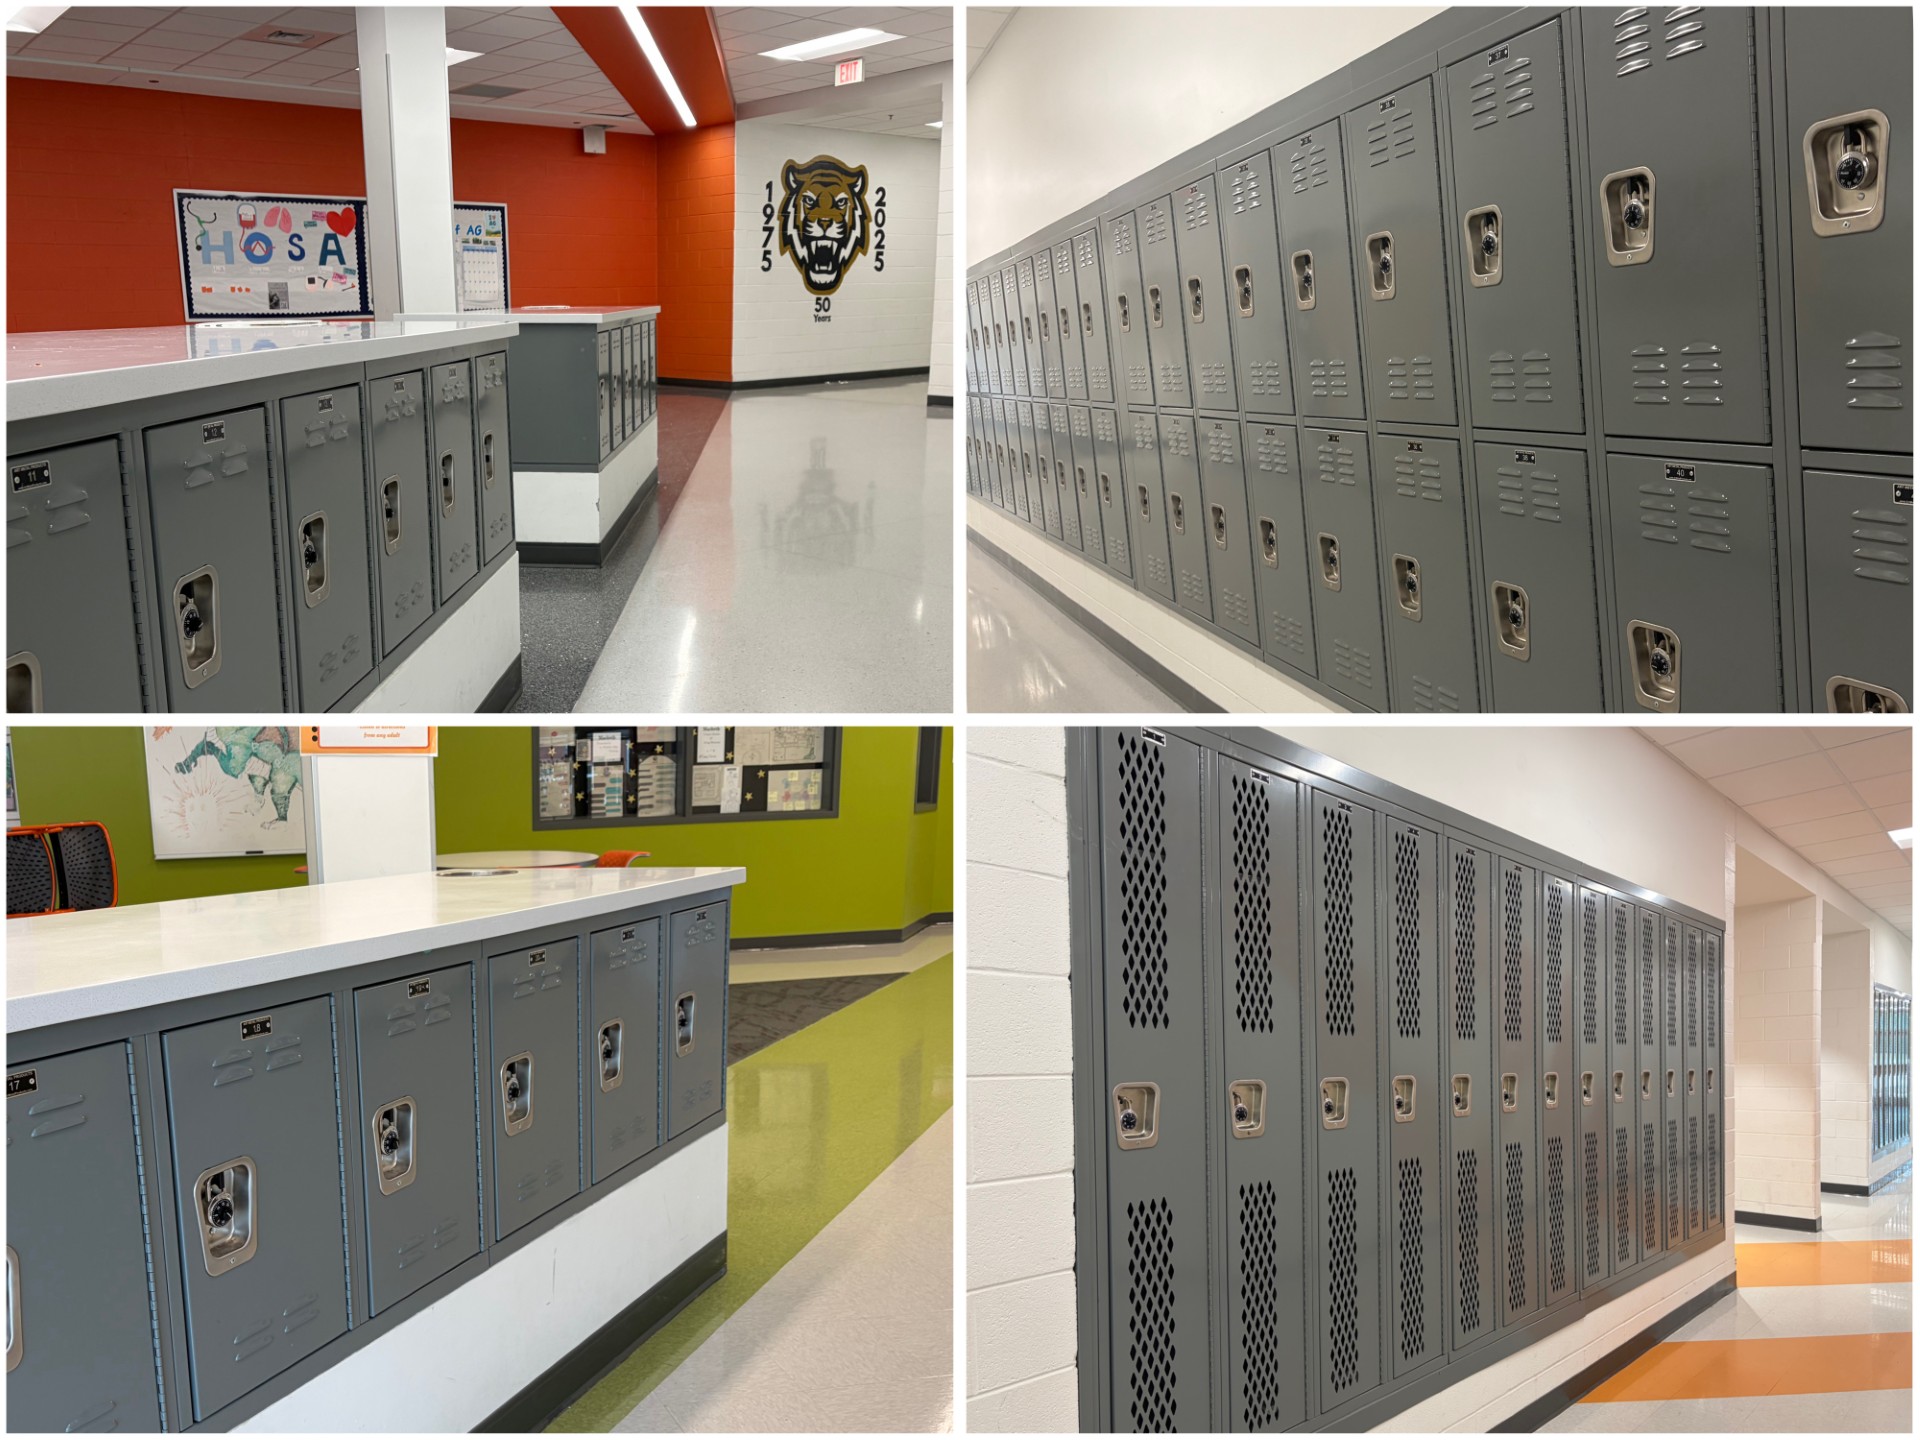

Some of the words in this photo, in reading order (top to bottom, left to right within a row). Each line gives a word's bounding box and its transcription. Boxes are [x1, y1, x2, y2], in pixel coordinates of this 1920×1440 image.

[840, 61, 858, 83] EXIT
[466, 225, 482, 236] AG
[761, 181, 775, 272] 1975
[874, 187, 886, 272] 2025
[201, 230, 346, 266] HOSA
[814, 297, 831, 313] 50
[813, 314, 832, 323] Years
[28, 470, 37, 482] 11
[1676, 469, 1685, 477] 40
[9, 1080, 20, 1092] 17
